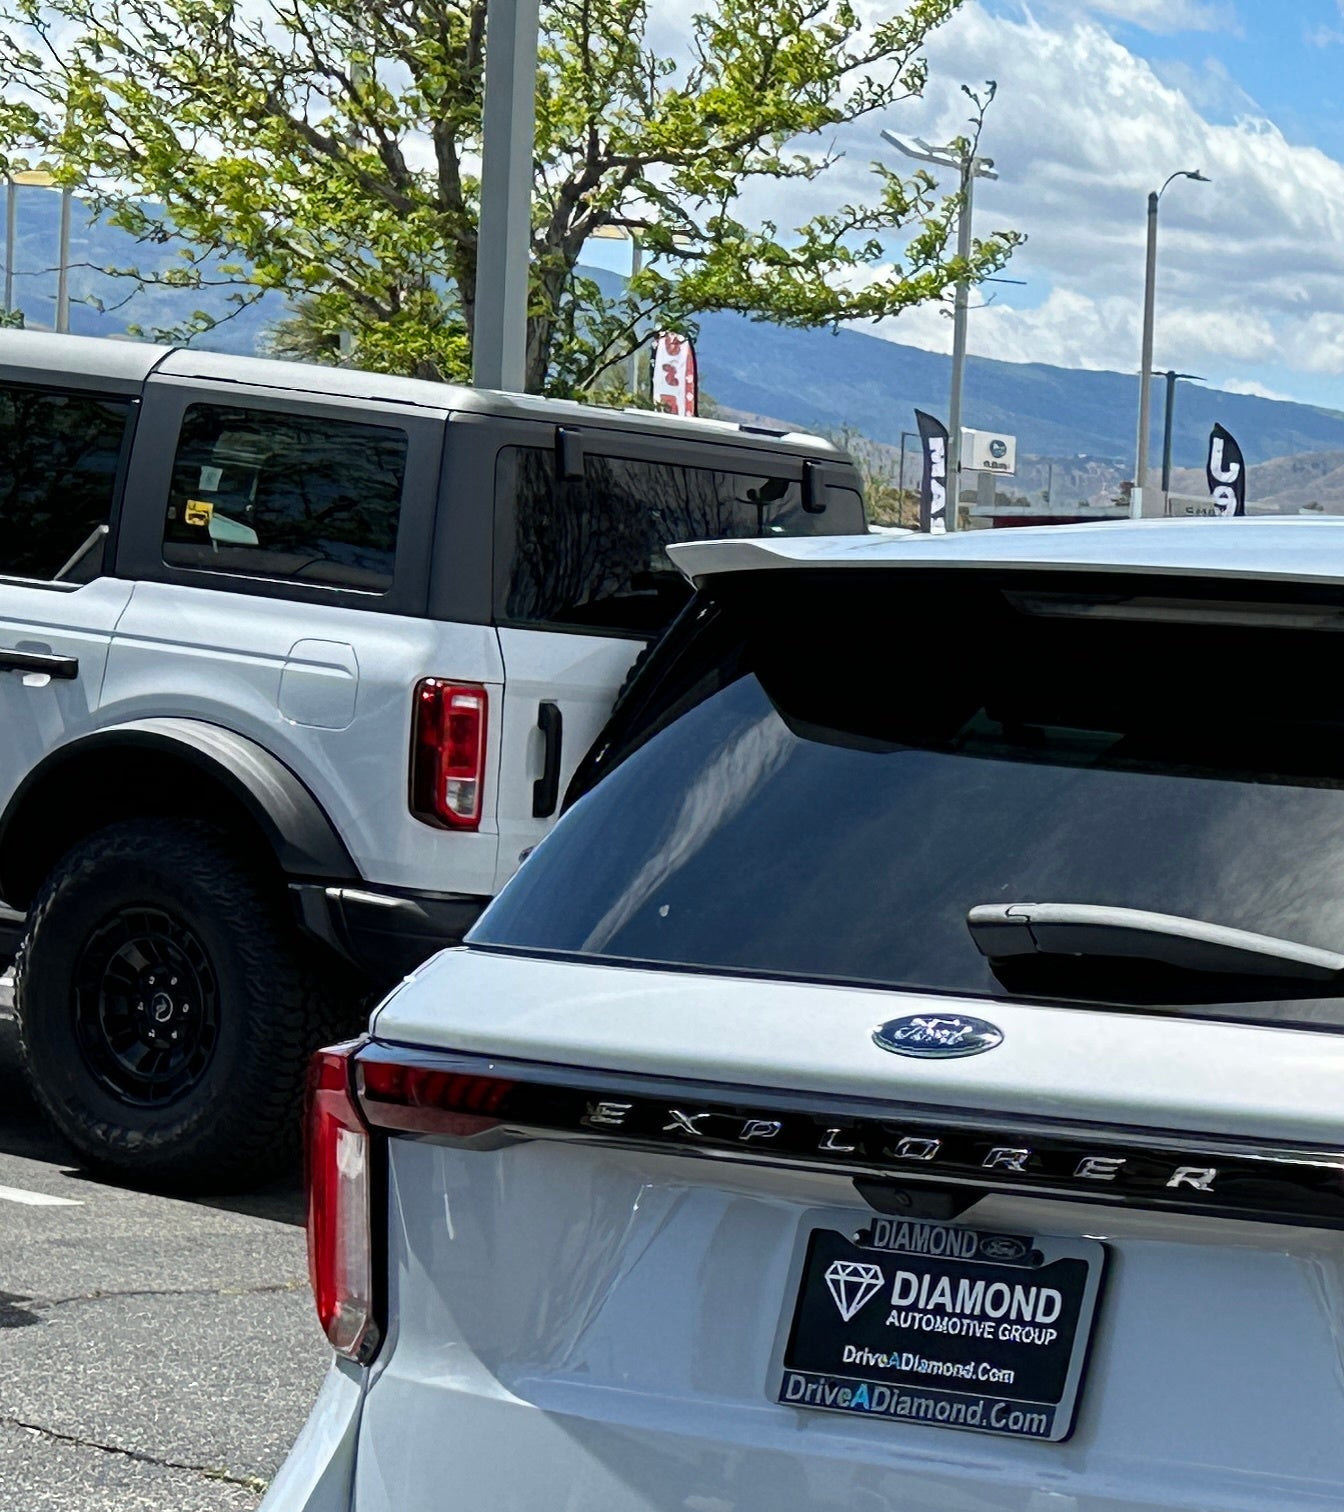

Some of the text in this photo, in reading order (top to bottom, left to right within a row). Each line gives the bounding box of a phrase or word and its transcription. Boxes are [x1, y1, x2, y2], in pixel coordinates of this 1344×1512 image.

[893, 1017, 974, 1046] Ford
[588, 1101, 1217, 1192] EXPLORER
[873, 1219, 979, 1258] DIAMOND
[889, 1269, 1063, 1325] DIAMOND
[885, 1309, 1058, 1346] AUTOMOTIVE GROUP
[842, 1345, 1015, 1385] DriveADiamond.Com
[785, 1374, 1049, 1435] DriveADiamond.Com
